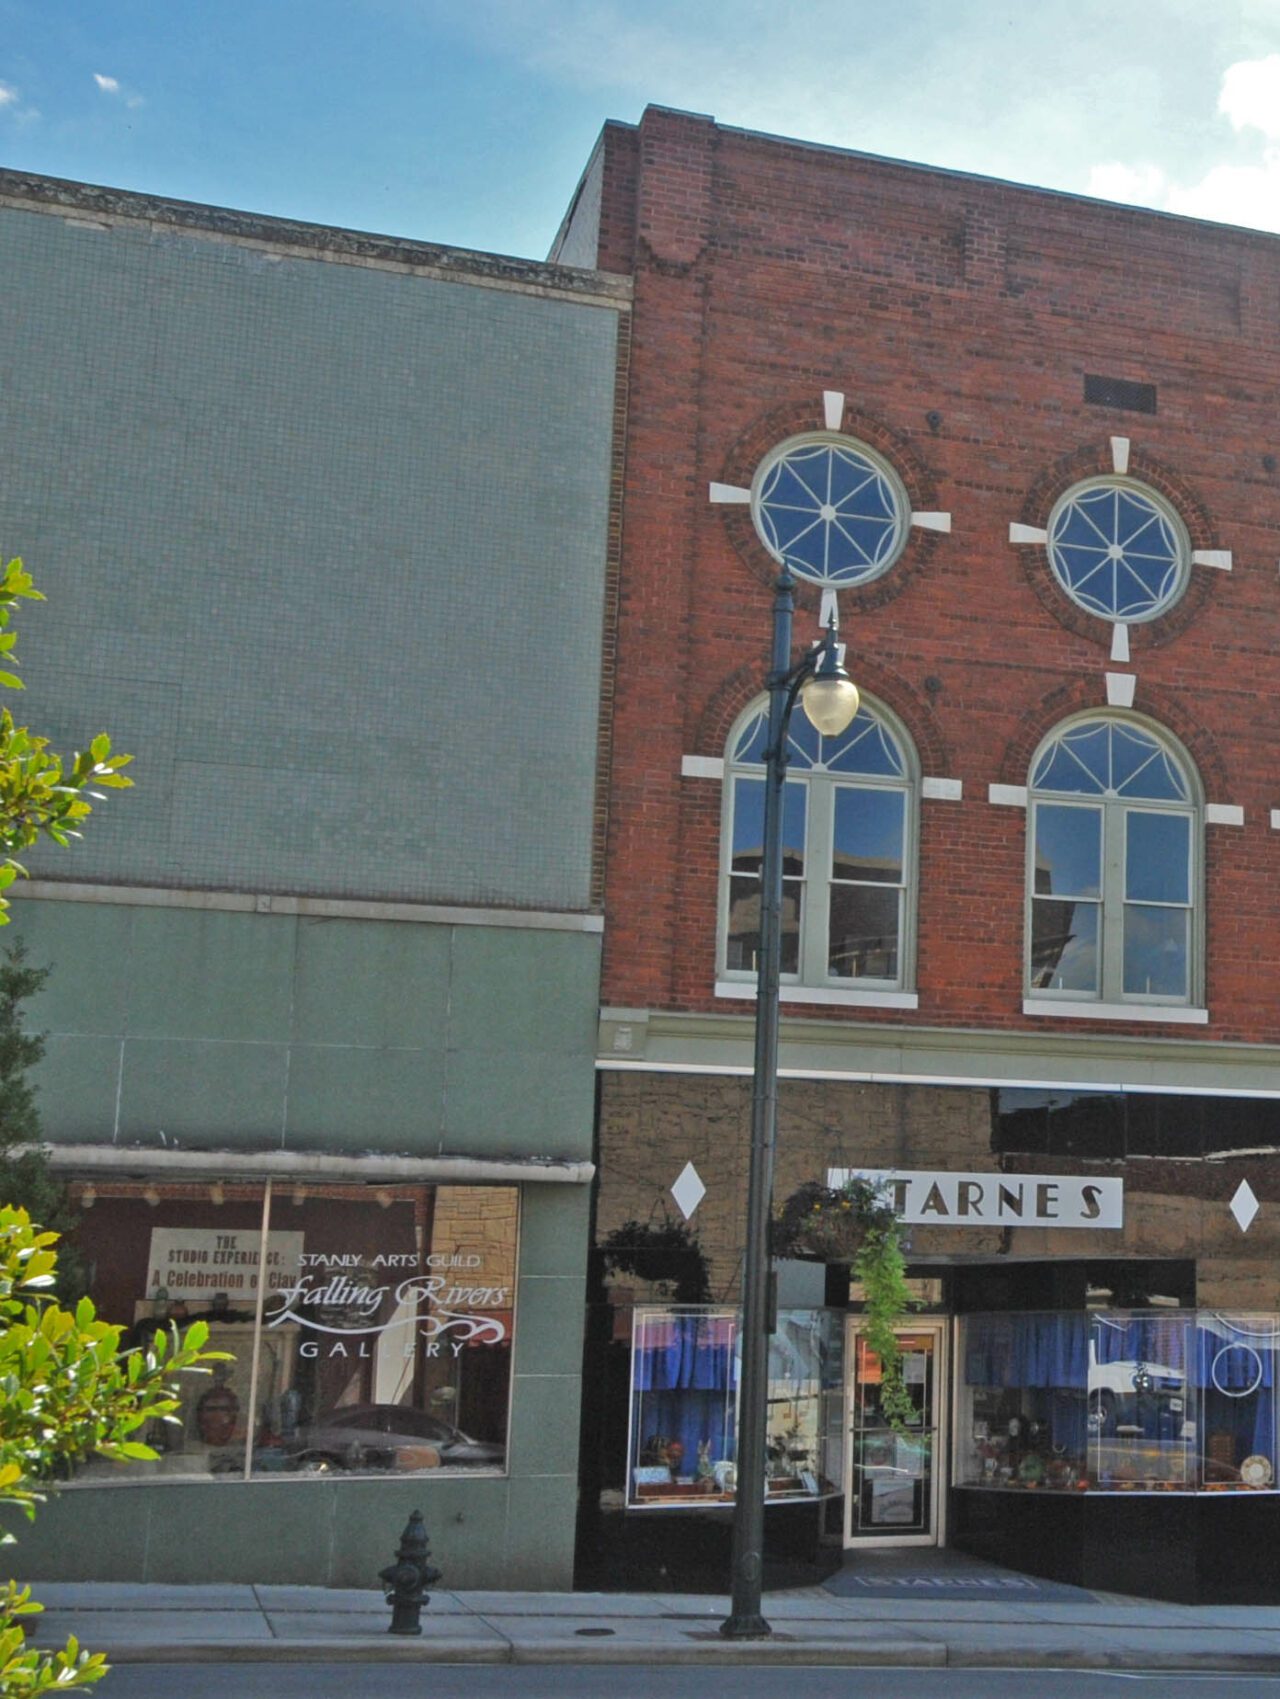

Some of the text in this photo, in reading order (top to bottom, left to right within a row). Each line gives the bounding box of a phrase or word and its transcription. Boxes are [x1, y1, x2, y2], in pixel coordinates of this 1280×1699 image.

[860, 1179, 1103, 1219] TARNES
[216, 1235, 237, 1249] THE
[168, 1249, 208, 1264] STUDIO
[297, 1254, 481, 1268] STANLY ARTS GUILD
[152, 1270, 160, 1287] A
[166, 1270, 244, 1289] Celebration
[395, 1275, 509, 1306] Rivers
